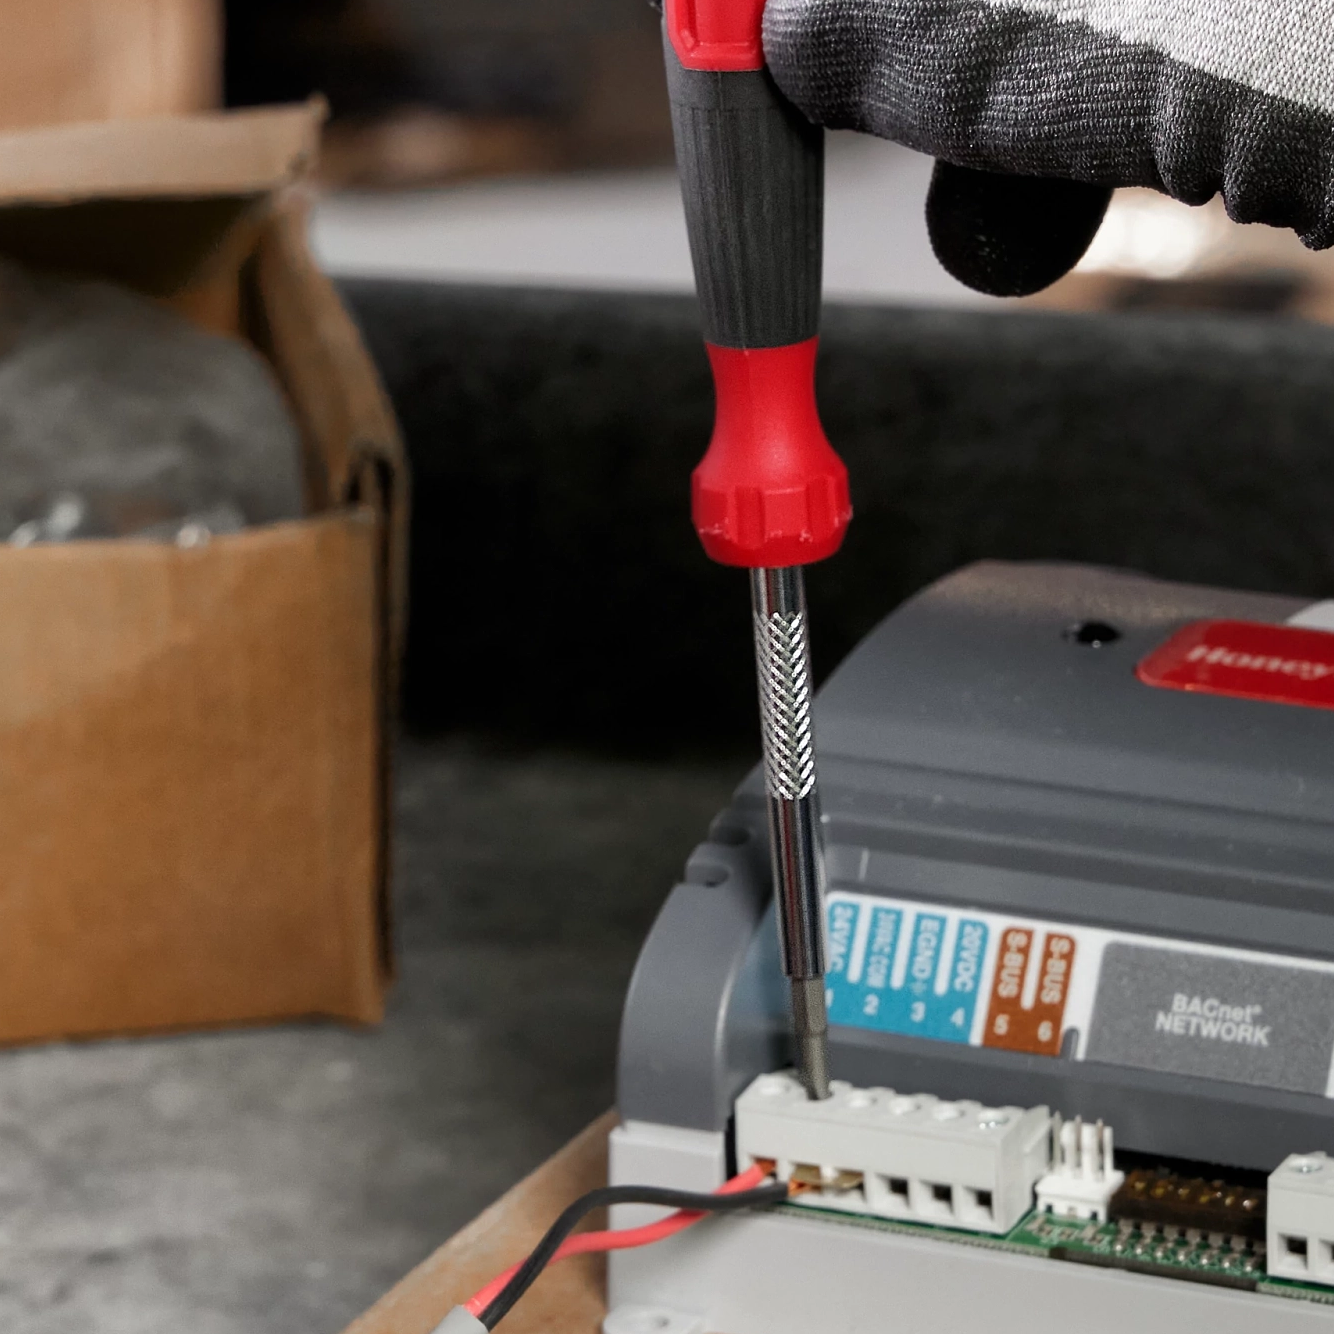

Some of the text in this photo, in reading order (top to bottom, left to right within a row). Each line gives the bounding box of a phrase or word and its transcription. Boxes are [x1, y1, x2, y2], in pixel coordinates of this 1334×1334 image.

[829, 904, 854, 972] 24VAC
[953, 924, 982, 992] 20VDC
[997, 930, 1029, 998] S-BUS
[1040, 936, 1072, 1005] S-BUS
[863, 993, 880, 1016] 2
[910, 1001, 926, 1023] 3
[950, 1007, 965, 1028] 4
[993, 1013, 1053, 1042] 5 6
[1155, 1010, 1273, 1047] NETWORK
